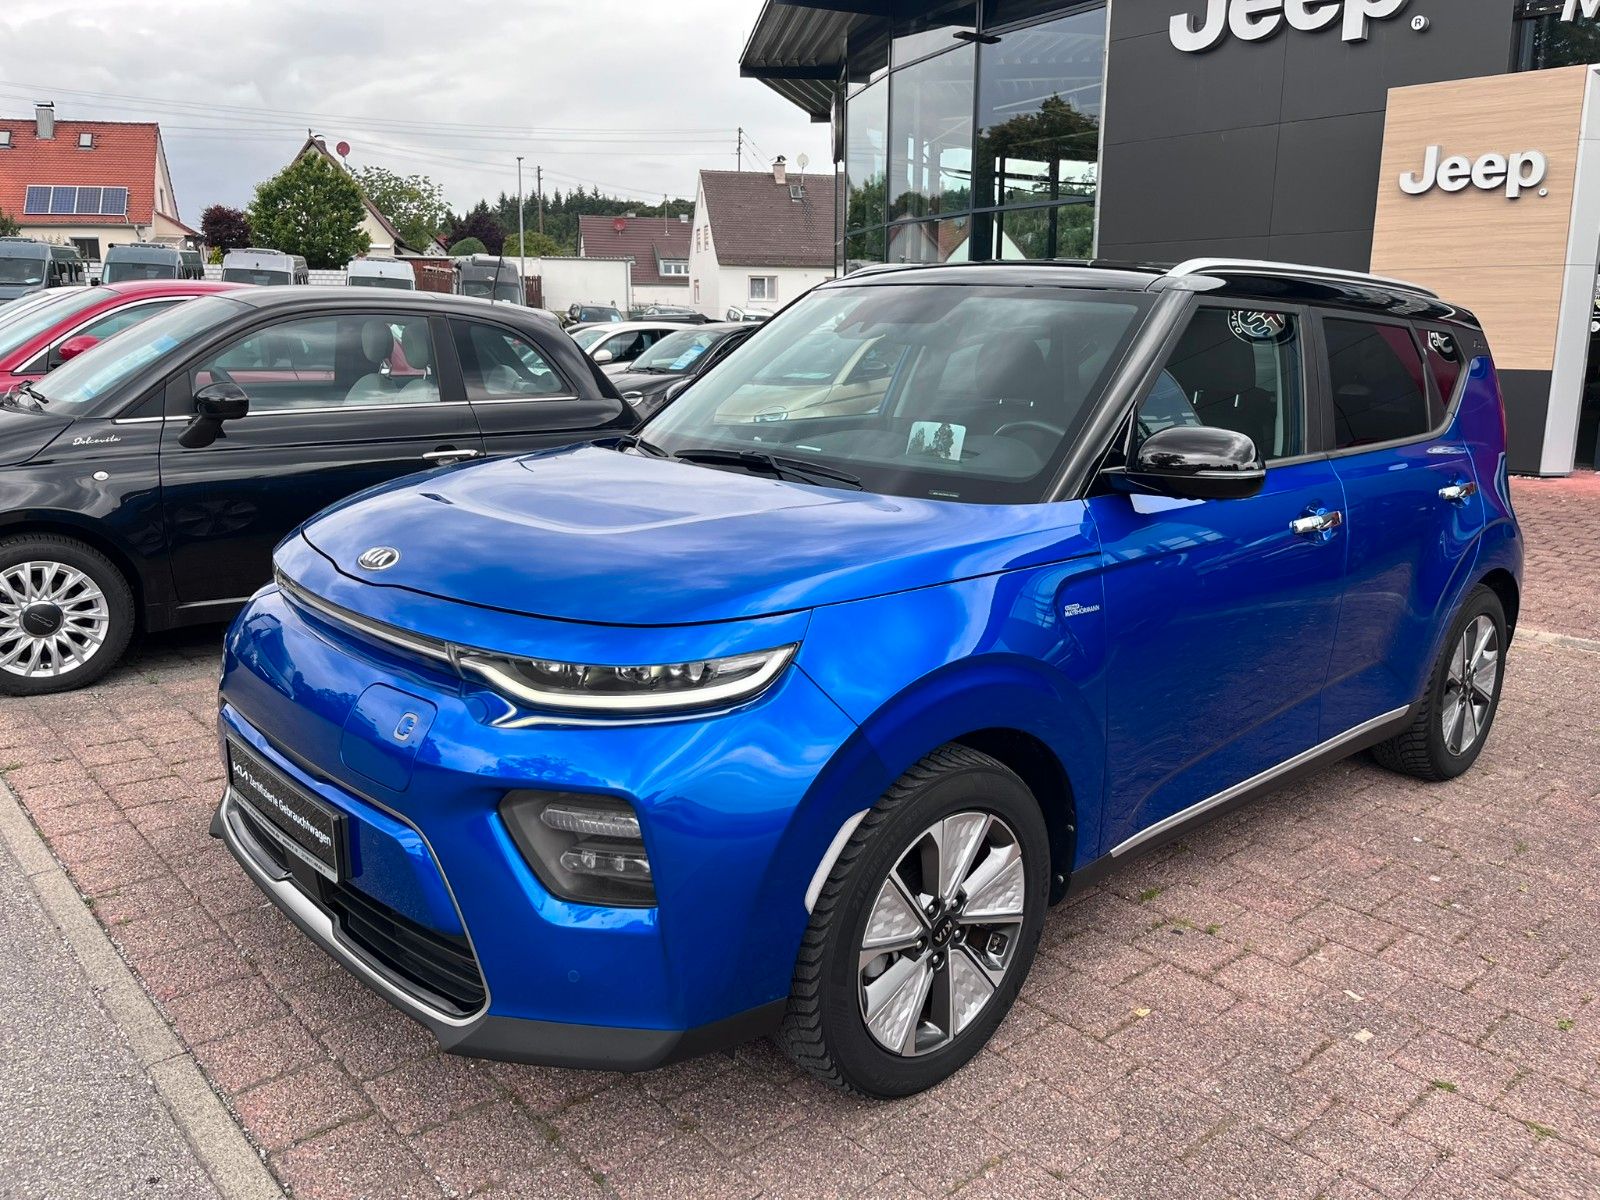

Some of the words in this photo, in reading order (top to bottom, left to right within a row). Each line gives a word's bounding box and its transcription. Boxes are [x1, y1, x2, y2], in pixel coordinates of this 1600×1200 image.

[1169, 0, 1408, 52] Jeep
[1399, 144, 1548, 199] Jeep
[72, 434, 121, 446] Dolcevita
[278, 799, 332, 847] Gebrauchtwagen
[934, 919, 953, 943] KIA
